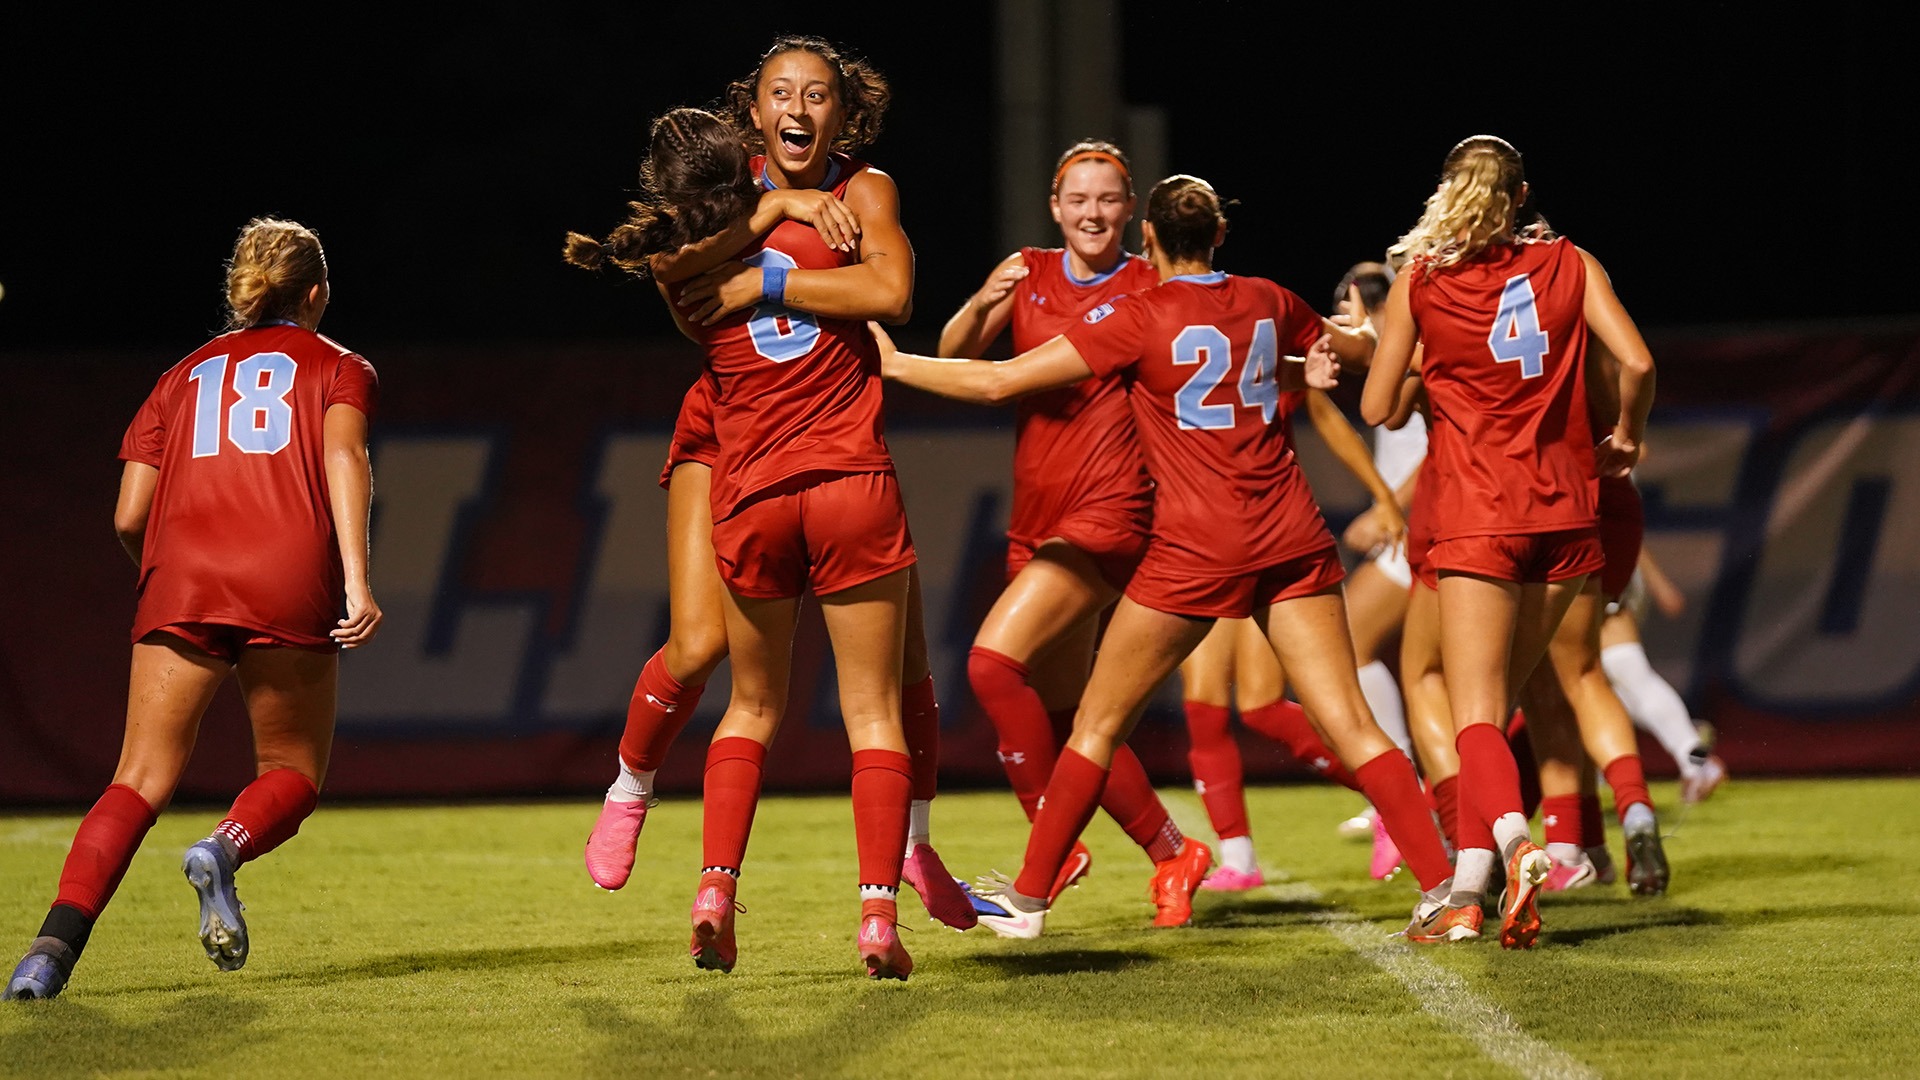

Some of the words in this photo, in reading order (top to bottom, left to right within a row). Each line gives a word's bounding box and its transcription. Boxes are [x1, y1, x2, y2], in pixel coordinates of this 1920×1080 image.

[1171, 318, 1279, 430] 24
[1487, 273, 1550, 380] 4
[188, 351, 298, 459] 18
